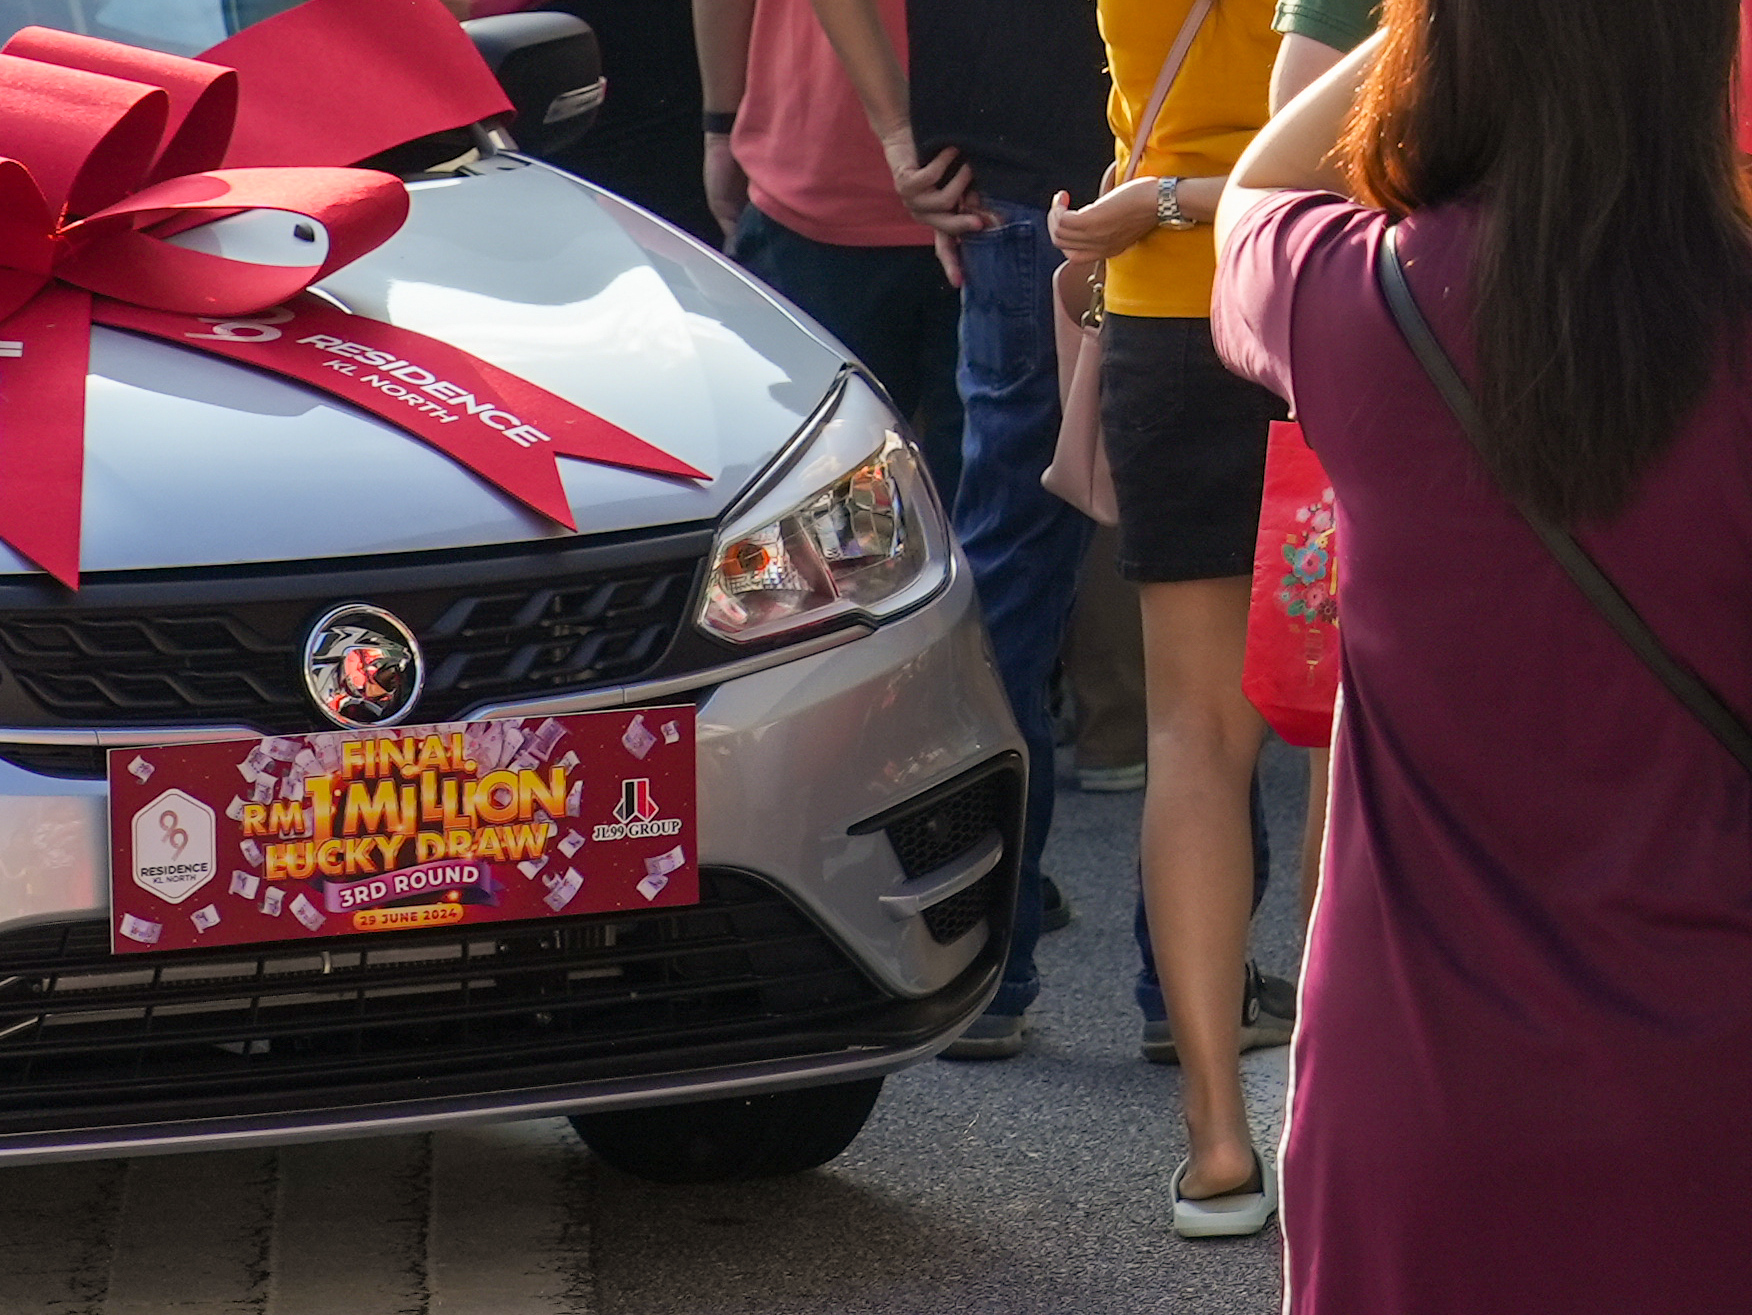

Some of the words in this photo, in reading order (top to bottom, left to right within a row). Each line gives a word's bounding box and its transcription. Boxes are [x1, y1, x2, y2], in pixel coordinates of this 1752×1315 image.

[295, 334, 551, 448] RESIDENCE
[322, 359, 355, 377] KL
[359, 373, 460, 425] NORTH
[341, 732, 468, 780] FINAL
[263, 833, 406, 881] LUCKY
[415, 822, 549, 864] DRAW
[594, 825, 626, 839] JL99
[628, 820, 680, 836] GROUP
[140, 862, 208, 877] RESIDENCE
[166, 874, 197, 883] NORTH
[339, 880, 388, 909] 3RD
[393, 865, 480, 894] ROUND
[359, 914, 376, 926] 29
[381, 911, 419, 924] JUNE
[422, 908, 457, 921] 2024
